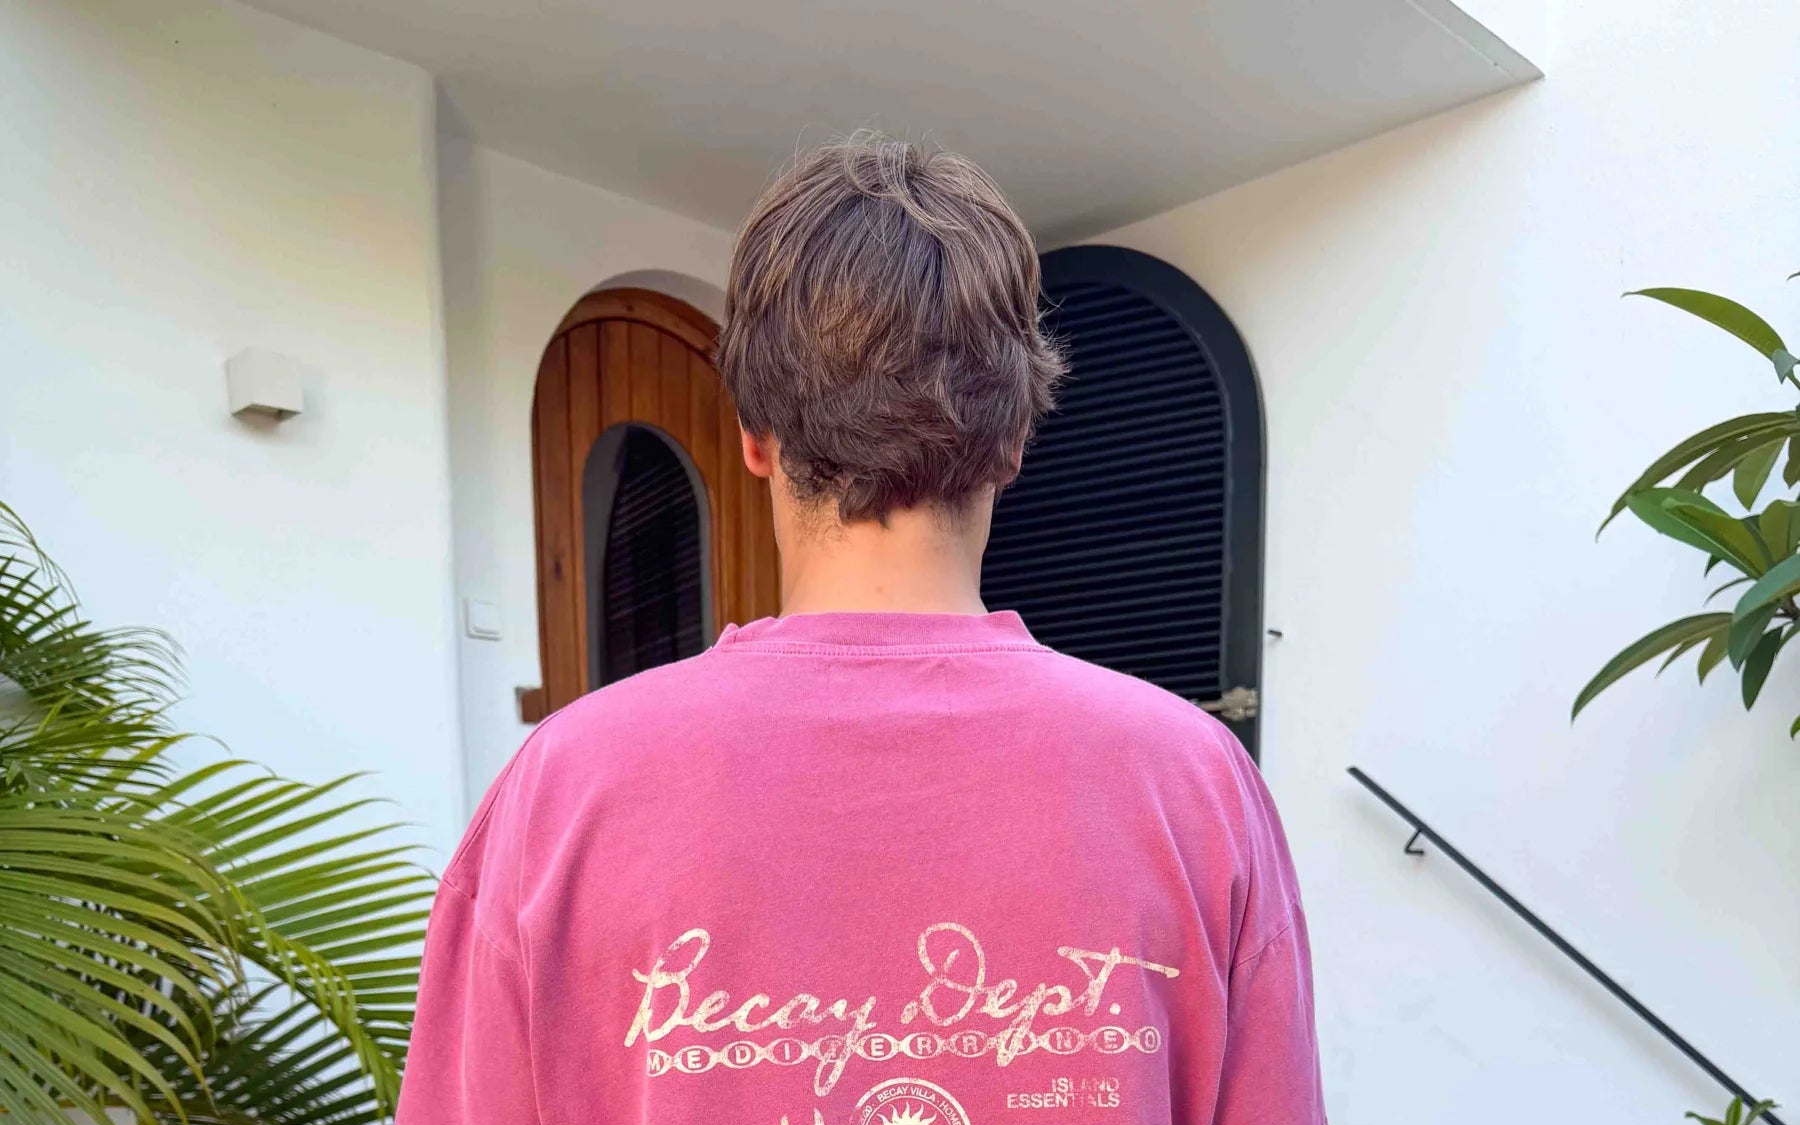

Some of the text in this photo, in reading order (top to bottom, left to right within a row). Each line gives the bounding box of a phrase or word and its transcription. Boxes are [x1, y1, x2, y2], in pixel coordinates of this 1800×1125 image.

[624, 928, 877, 1096] Becay
[877, 1086, 909, 1103] BECAY
[910, 1086, 936, 1102] VILLA
